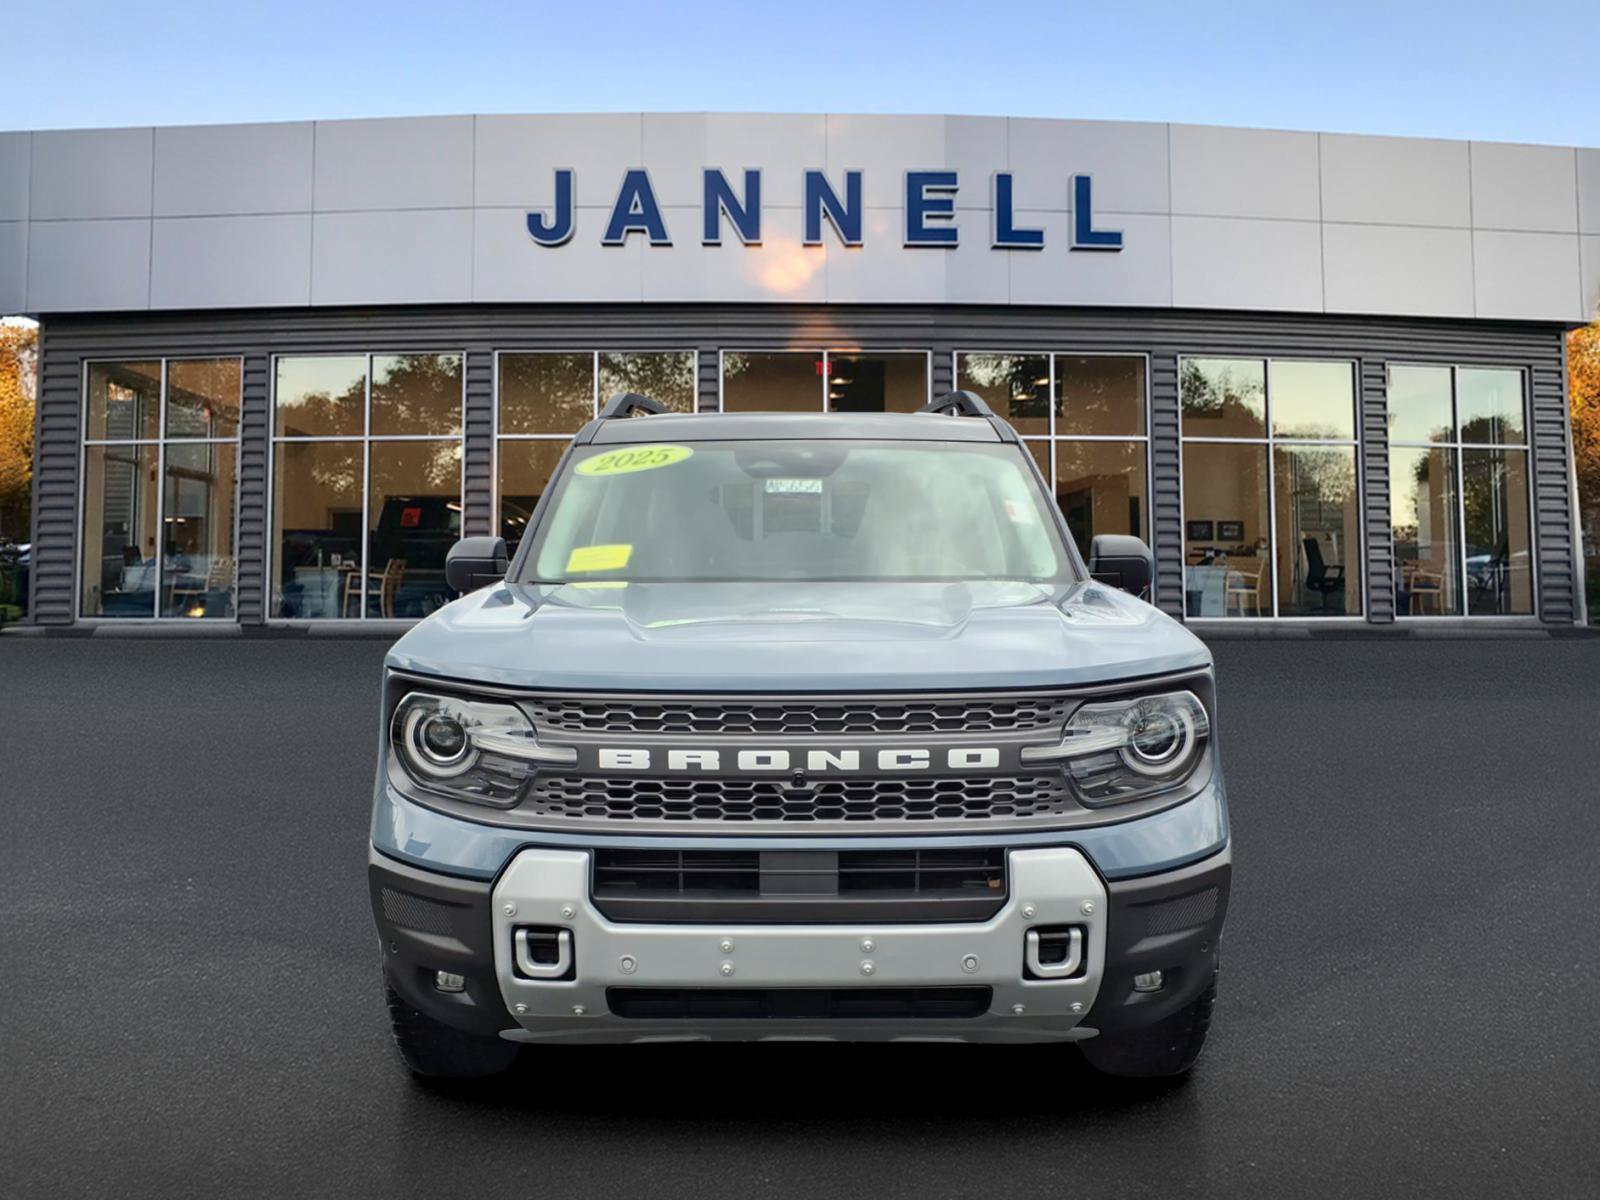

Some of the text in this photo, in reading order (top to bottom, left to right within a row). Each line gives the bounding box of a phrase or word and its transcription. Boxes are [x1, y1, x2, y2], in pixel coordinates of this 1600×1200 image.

[526, 167, 1123, 250] JANNELL
[594, 448, 674, 471] 2025
[599, 748, 999, 770] BRONCO
